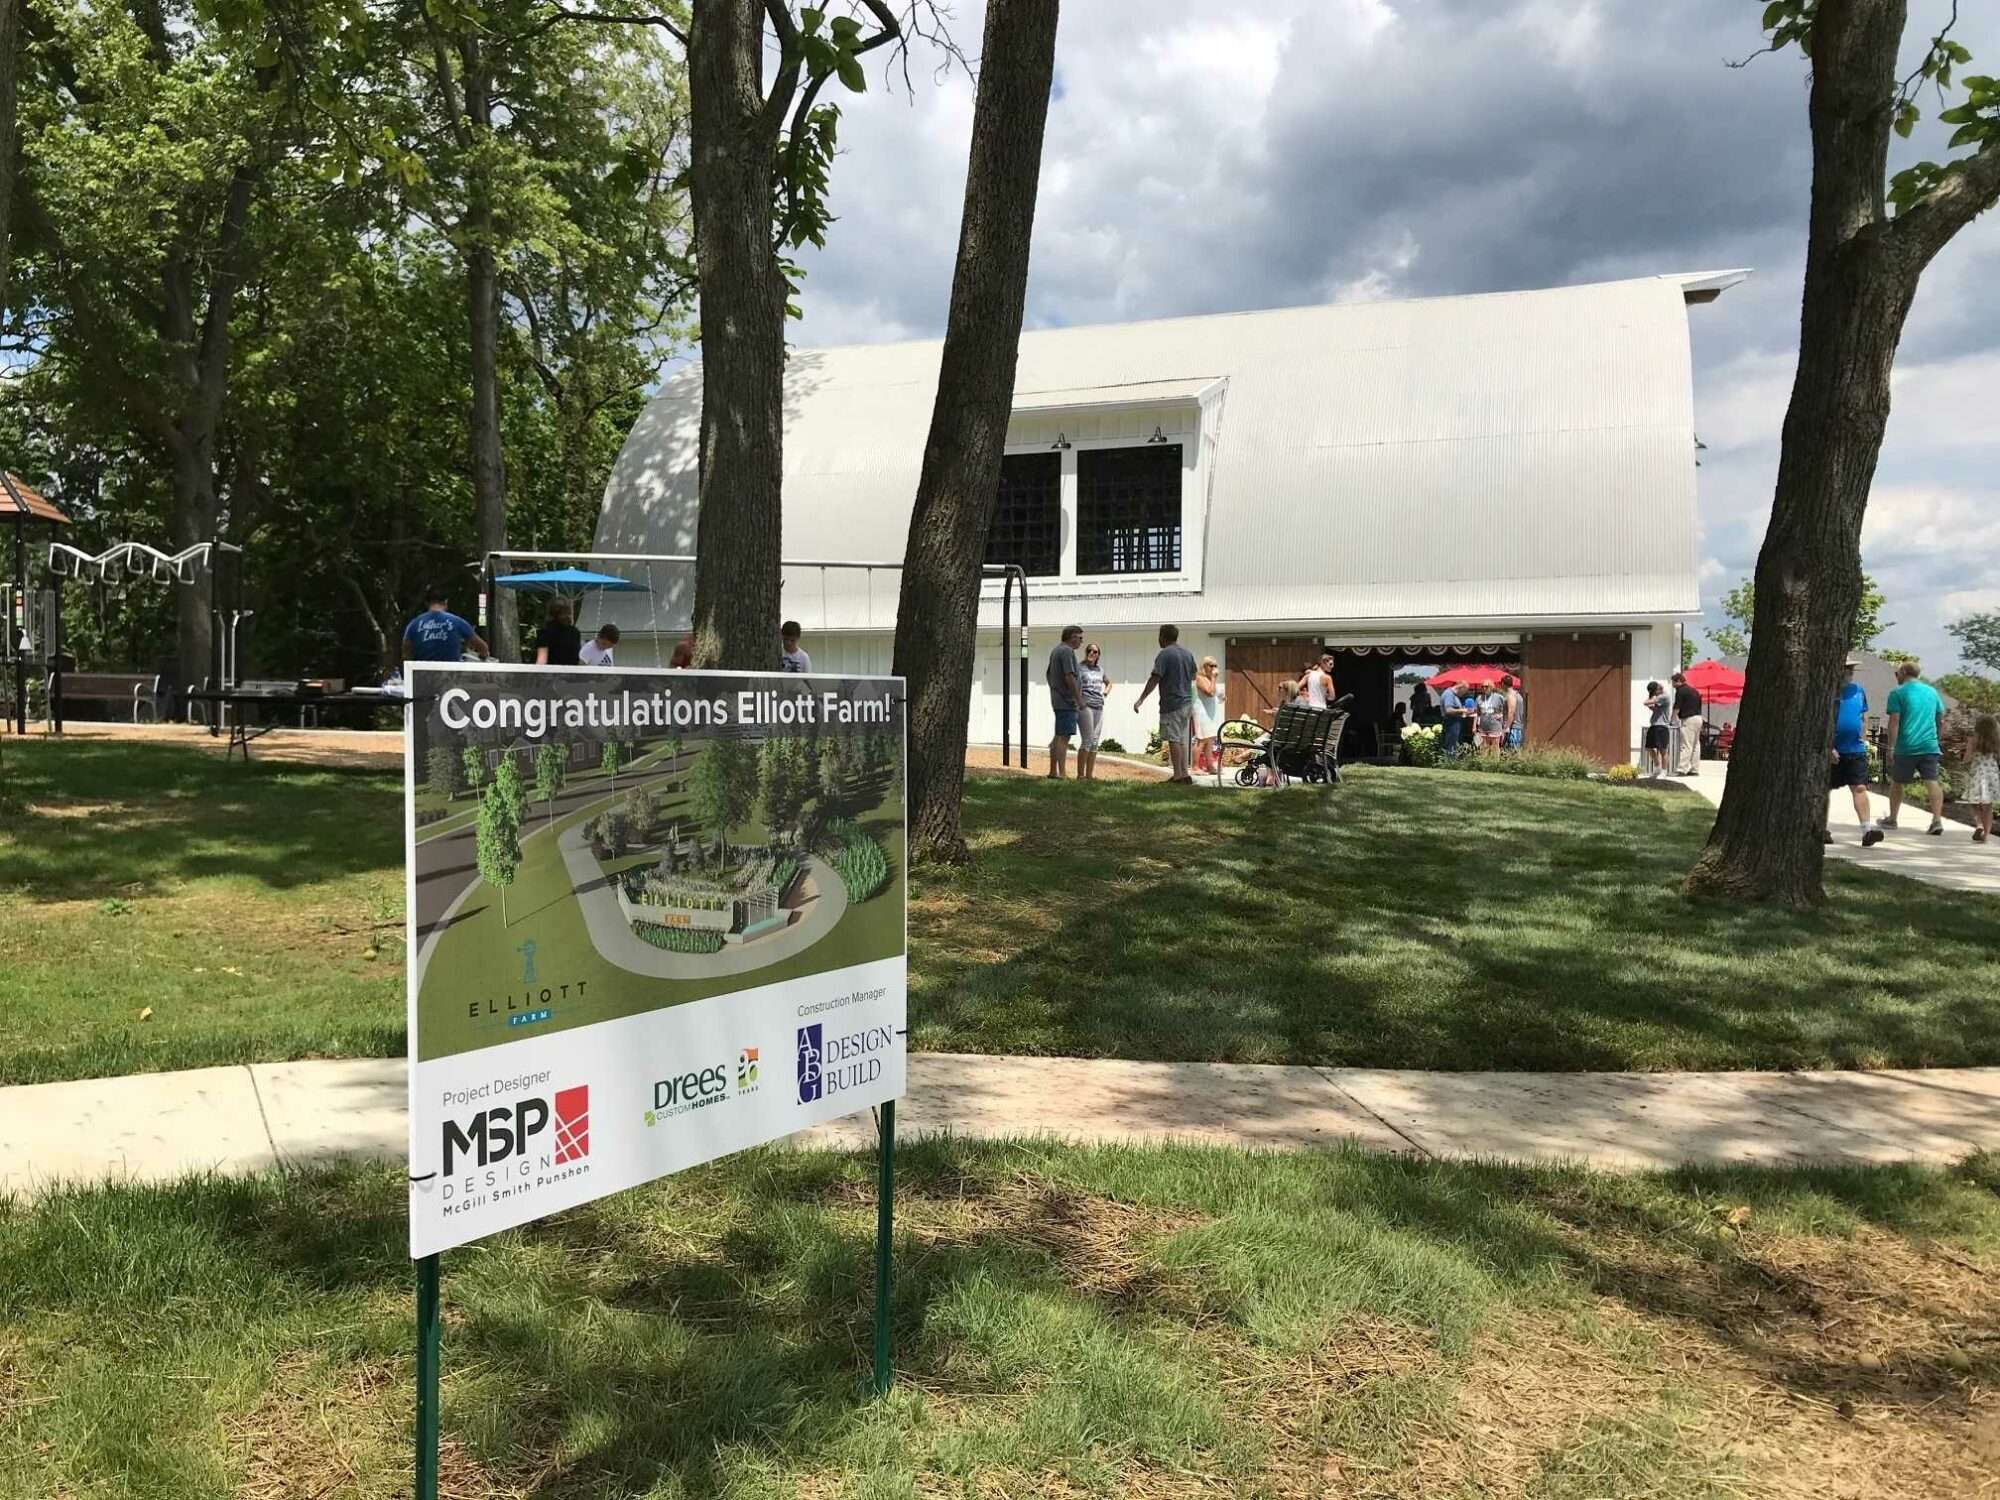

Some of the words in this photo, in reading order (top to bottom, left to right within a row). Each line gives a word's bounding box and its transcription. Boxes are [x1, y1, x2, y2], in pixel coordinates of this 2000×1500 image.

[439, 688, 728, 738] Congratulations
[738, 690, 815, 724] Elliott
[823, 692, 891, 723] Farm!
[469, 981, 587, 1018] ELLIOTT
[512, 1011, 549, 1025] FARM
[798, 996, 850, 1017] Construction
[852, 987, 887, 1004] Manager
[827, 1024, 893, 1064] DESIGN
[443, 1084, 490, 1107] Project
[494, 1070, 552, 1094] Designer
[654, 1064, 727, 1110] Drees
[827, 1058, 881, 1095] BUILD
[442, 1097, 549, 1178] MSP
[442, 1154, 551, 1200] DESIGN
[443, 1195, 486, 1217] McGill
[492, 1183, 531, 1202] Smith
[537, 1164, 590, 1187] Punshon
